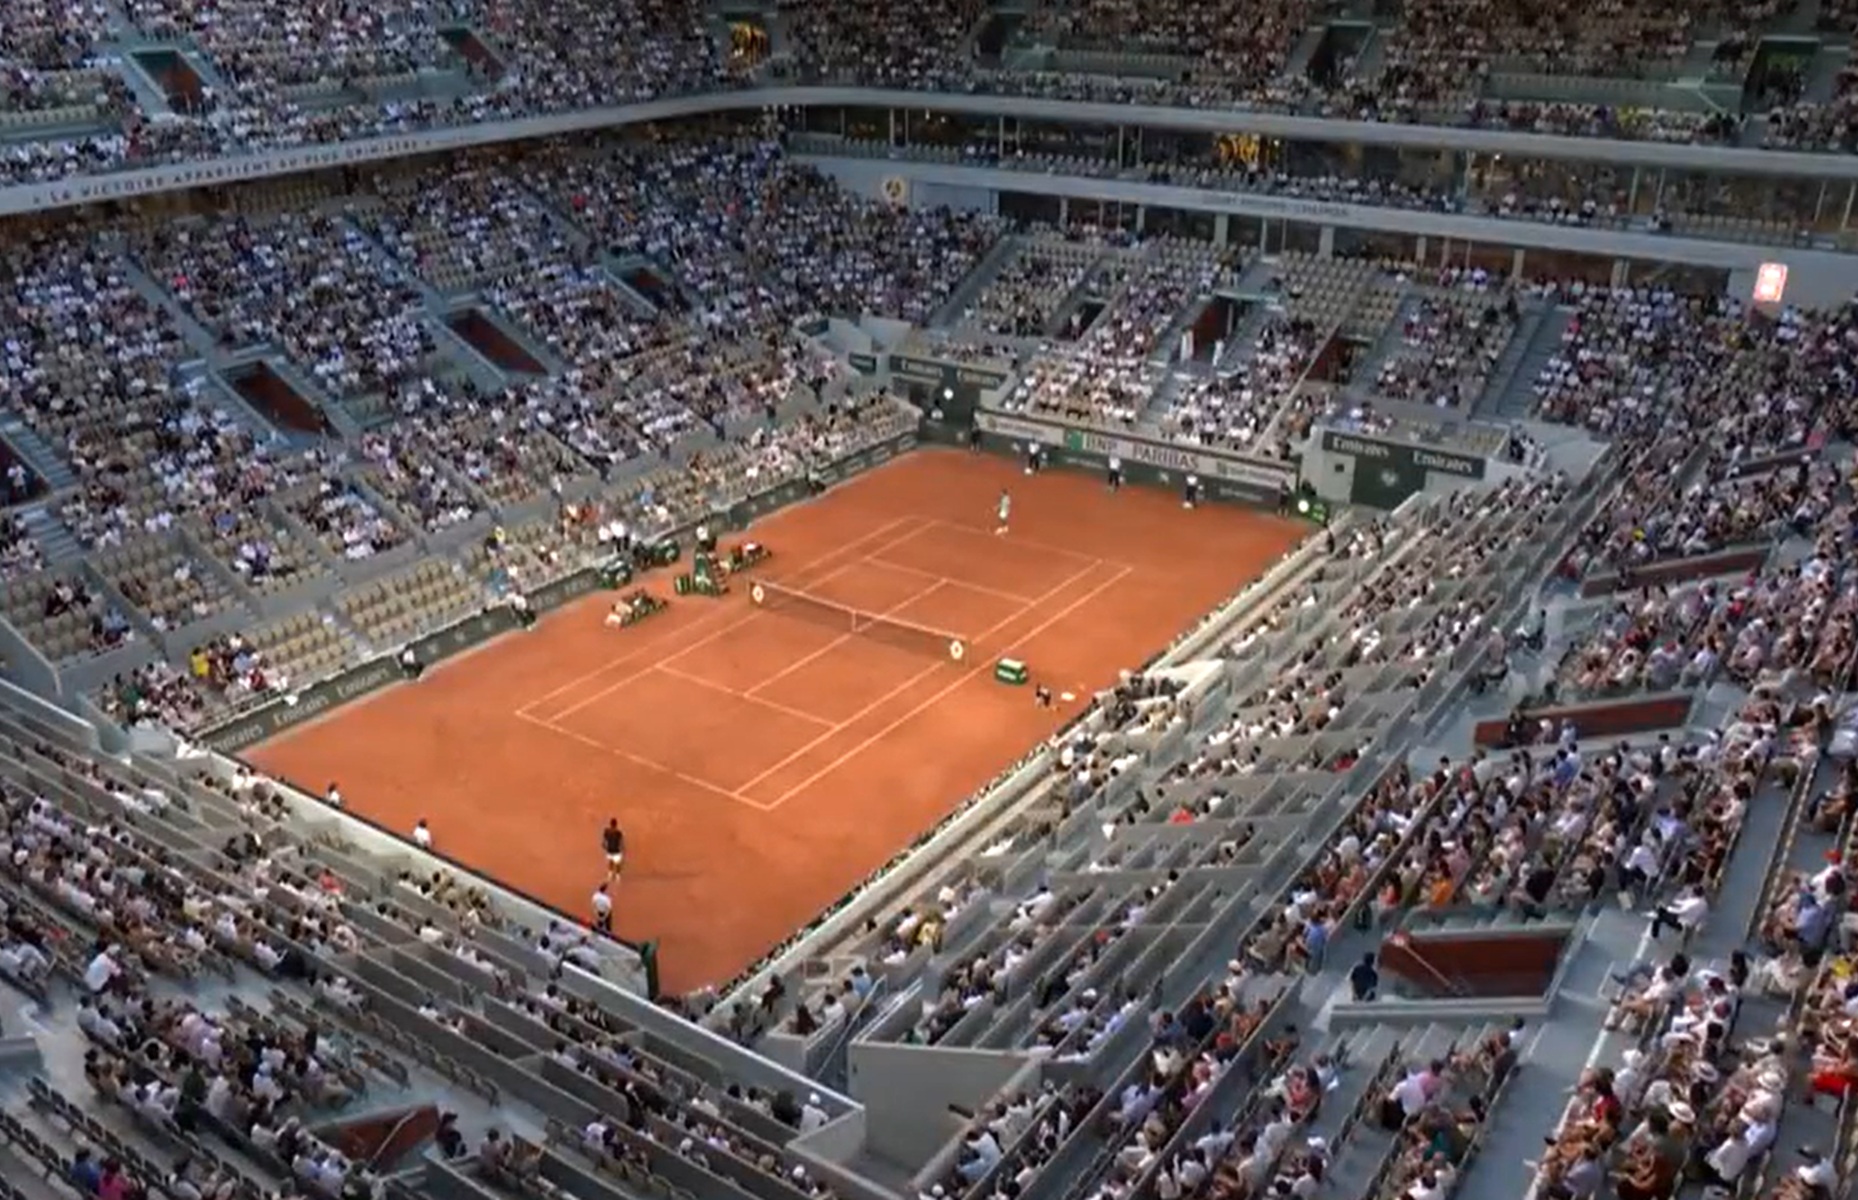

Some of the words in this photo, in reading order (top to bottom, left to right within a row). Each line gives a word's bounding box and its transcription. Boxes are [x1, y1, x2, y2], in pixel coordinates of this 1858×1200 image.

[1133, 442, 1199, 469] PARIBAS
[1332, 436, 1390, 457] Emirates
[1413, 450, 1473, 474] Emirates
